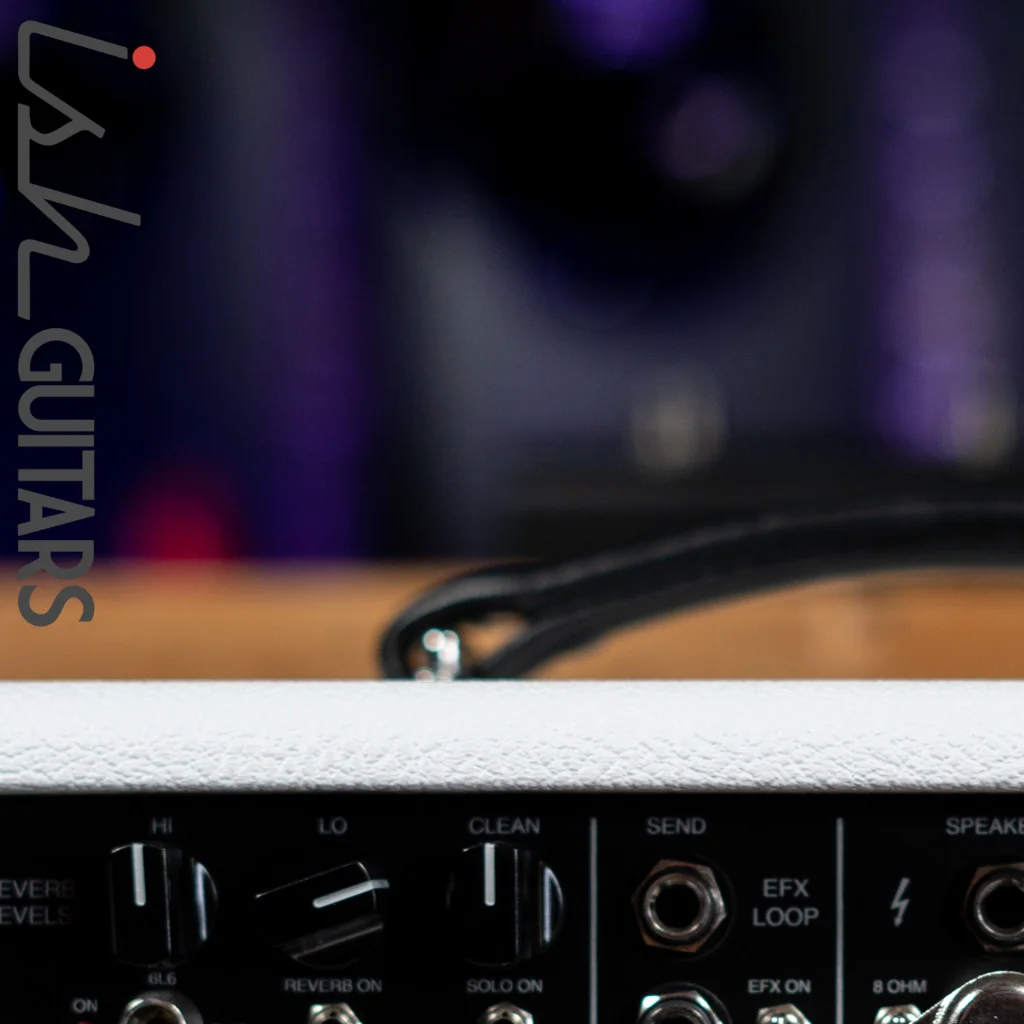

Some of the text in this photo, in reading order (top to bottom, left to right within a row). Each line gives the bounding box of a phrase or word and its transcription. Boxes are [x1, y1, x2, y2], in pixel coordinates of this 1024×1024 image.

[151, 817, 173, 834] HI
[318, 816, 348, 835] LO
[468, 817, 541, 835] CLEAN
[646, 817, 707, 836] SEND
[762, 878, 809, 898] EFX
[752, 906, 820, 927] LOOP
[284, 978, 383, 993] REVERB ON
[466, 978, 543, 994] SOLO ON
[747, 978, 812, 995] EFX ON
[872, 978, 927, 995] 8 OHM
[71, 998, 98, 1014] ON
